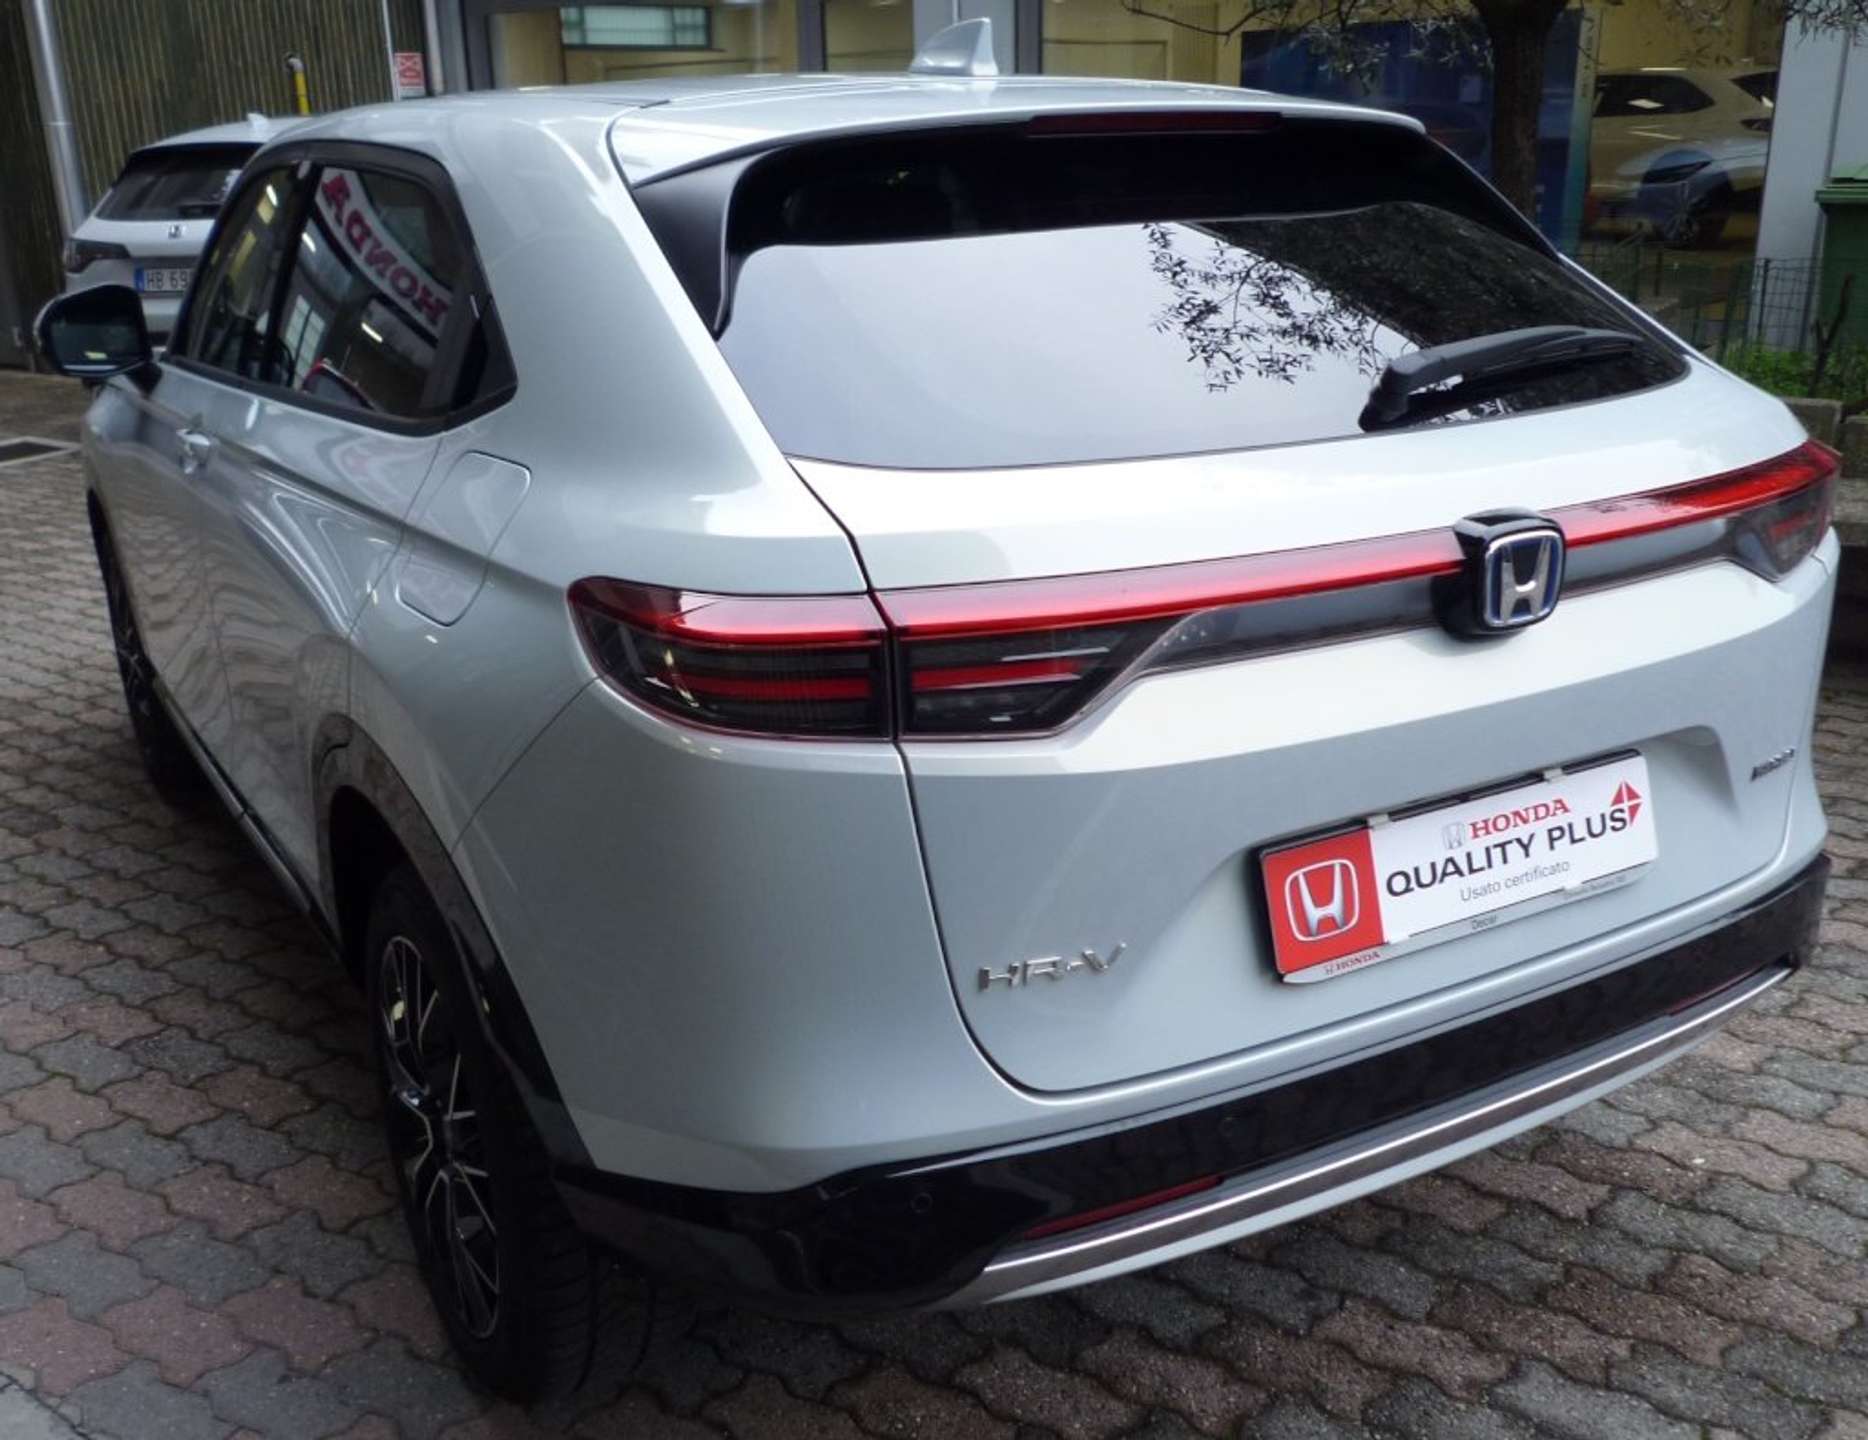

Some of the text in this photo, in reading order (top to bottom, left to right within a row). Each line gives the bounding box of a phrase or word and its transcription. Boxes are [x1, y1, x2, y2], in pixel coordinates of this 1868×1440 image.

[1469, 798, 1571, 840] HONDA
[1386, 833, 1535, 898] QUALITY
[1547, 808, 1628, 851] PLUS
[1460, 881, 1501, 902] Usato
[1504, 859, 1571, 889] certificato
[1336, 951, 1381, 971] HONDA
